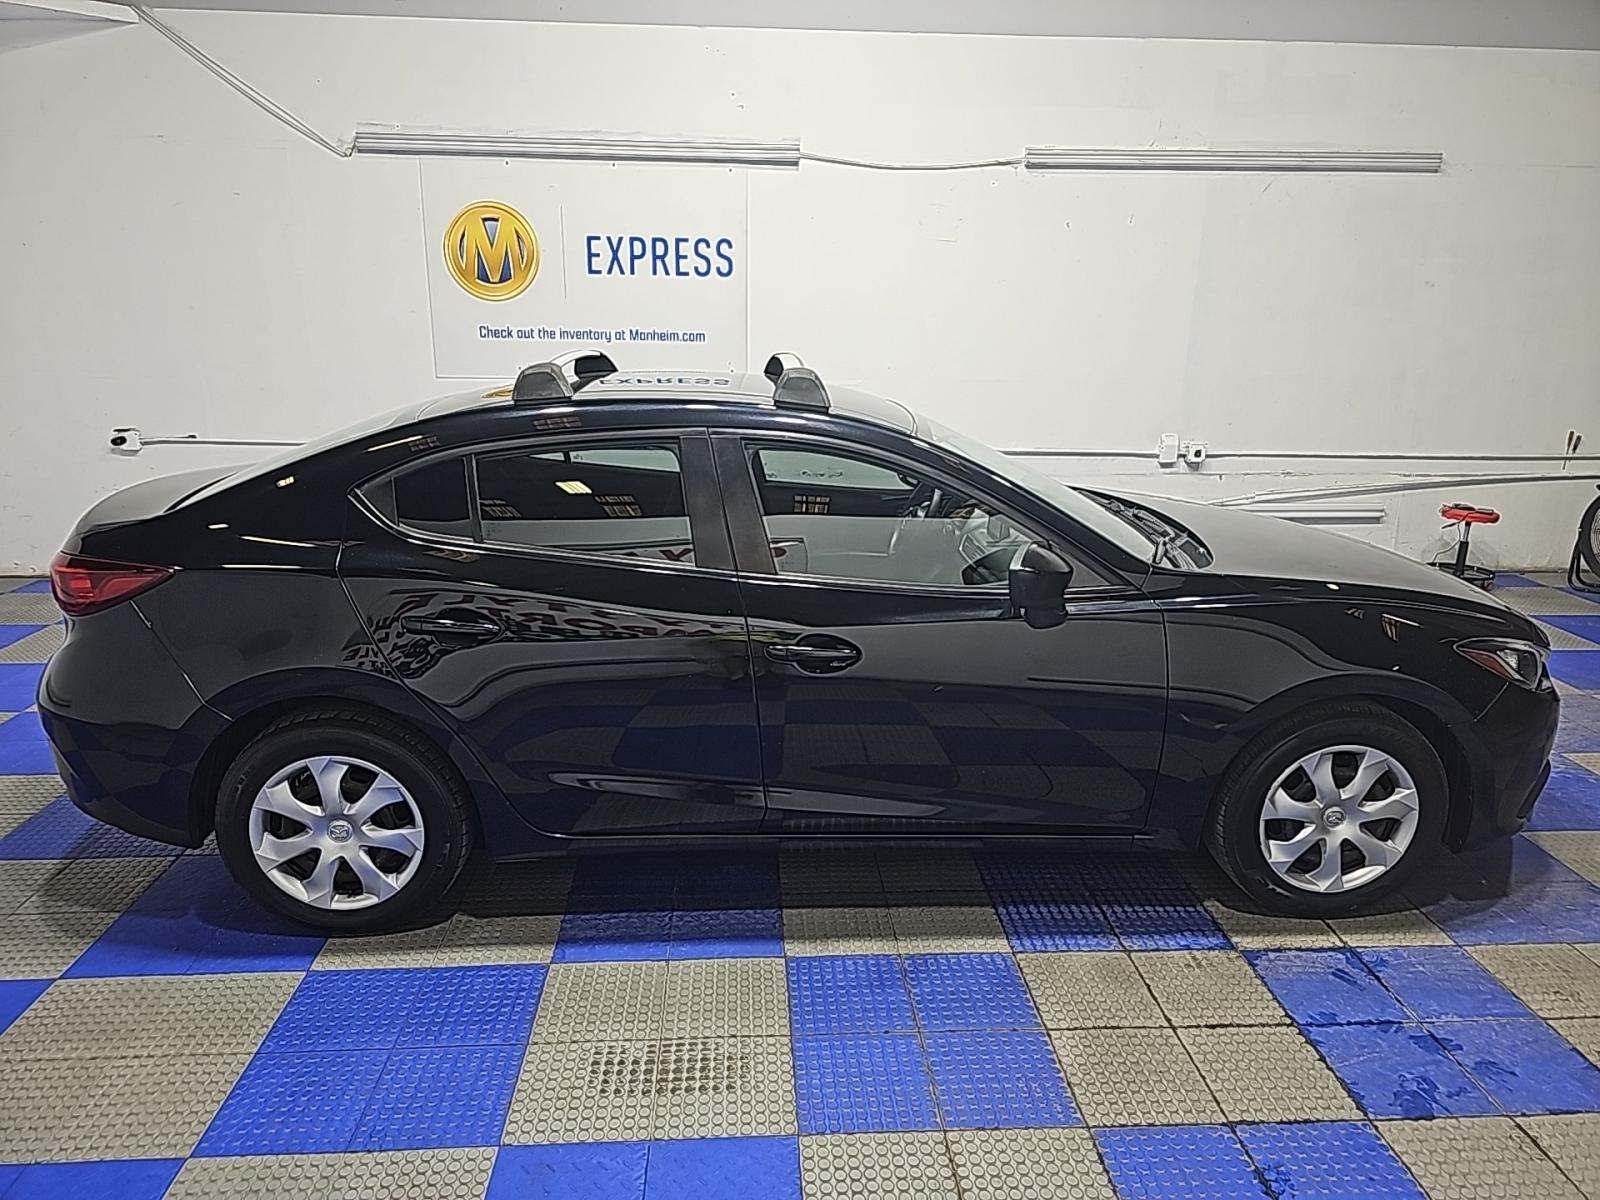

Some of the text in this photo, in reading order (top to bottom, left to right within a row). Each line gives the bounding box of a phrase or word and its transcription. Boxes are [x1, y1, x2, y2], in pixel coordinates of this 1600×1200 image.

[454, 213, 531, 287] M
[586, 235, 734, 278] EXPRESS
[478, 325, 706, 343] Check out the inventory at Manheim.com
